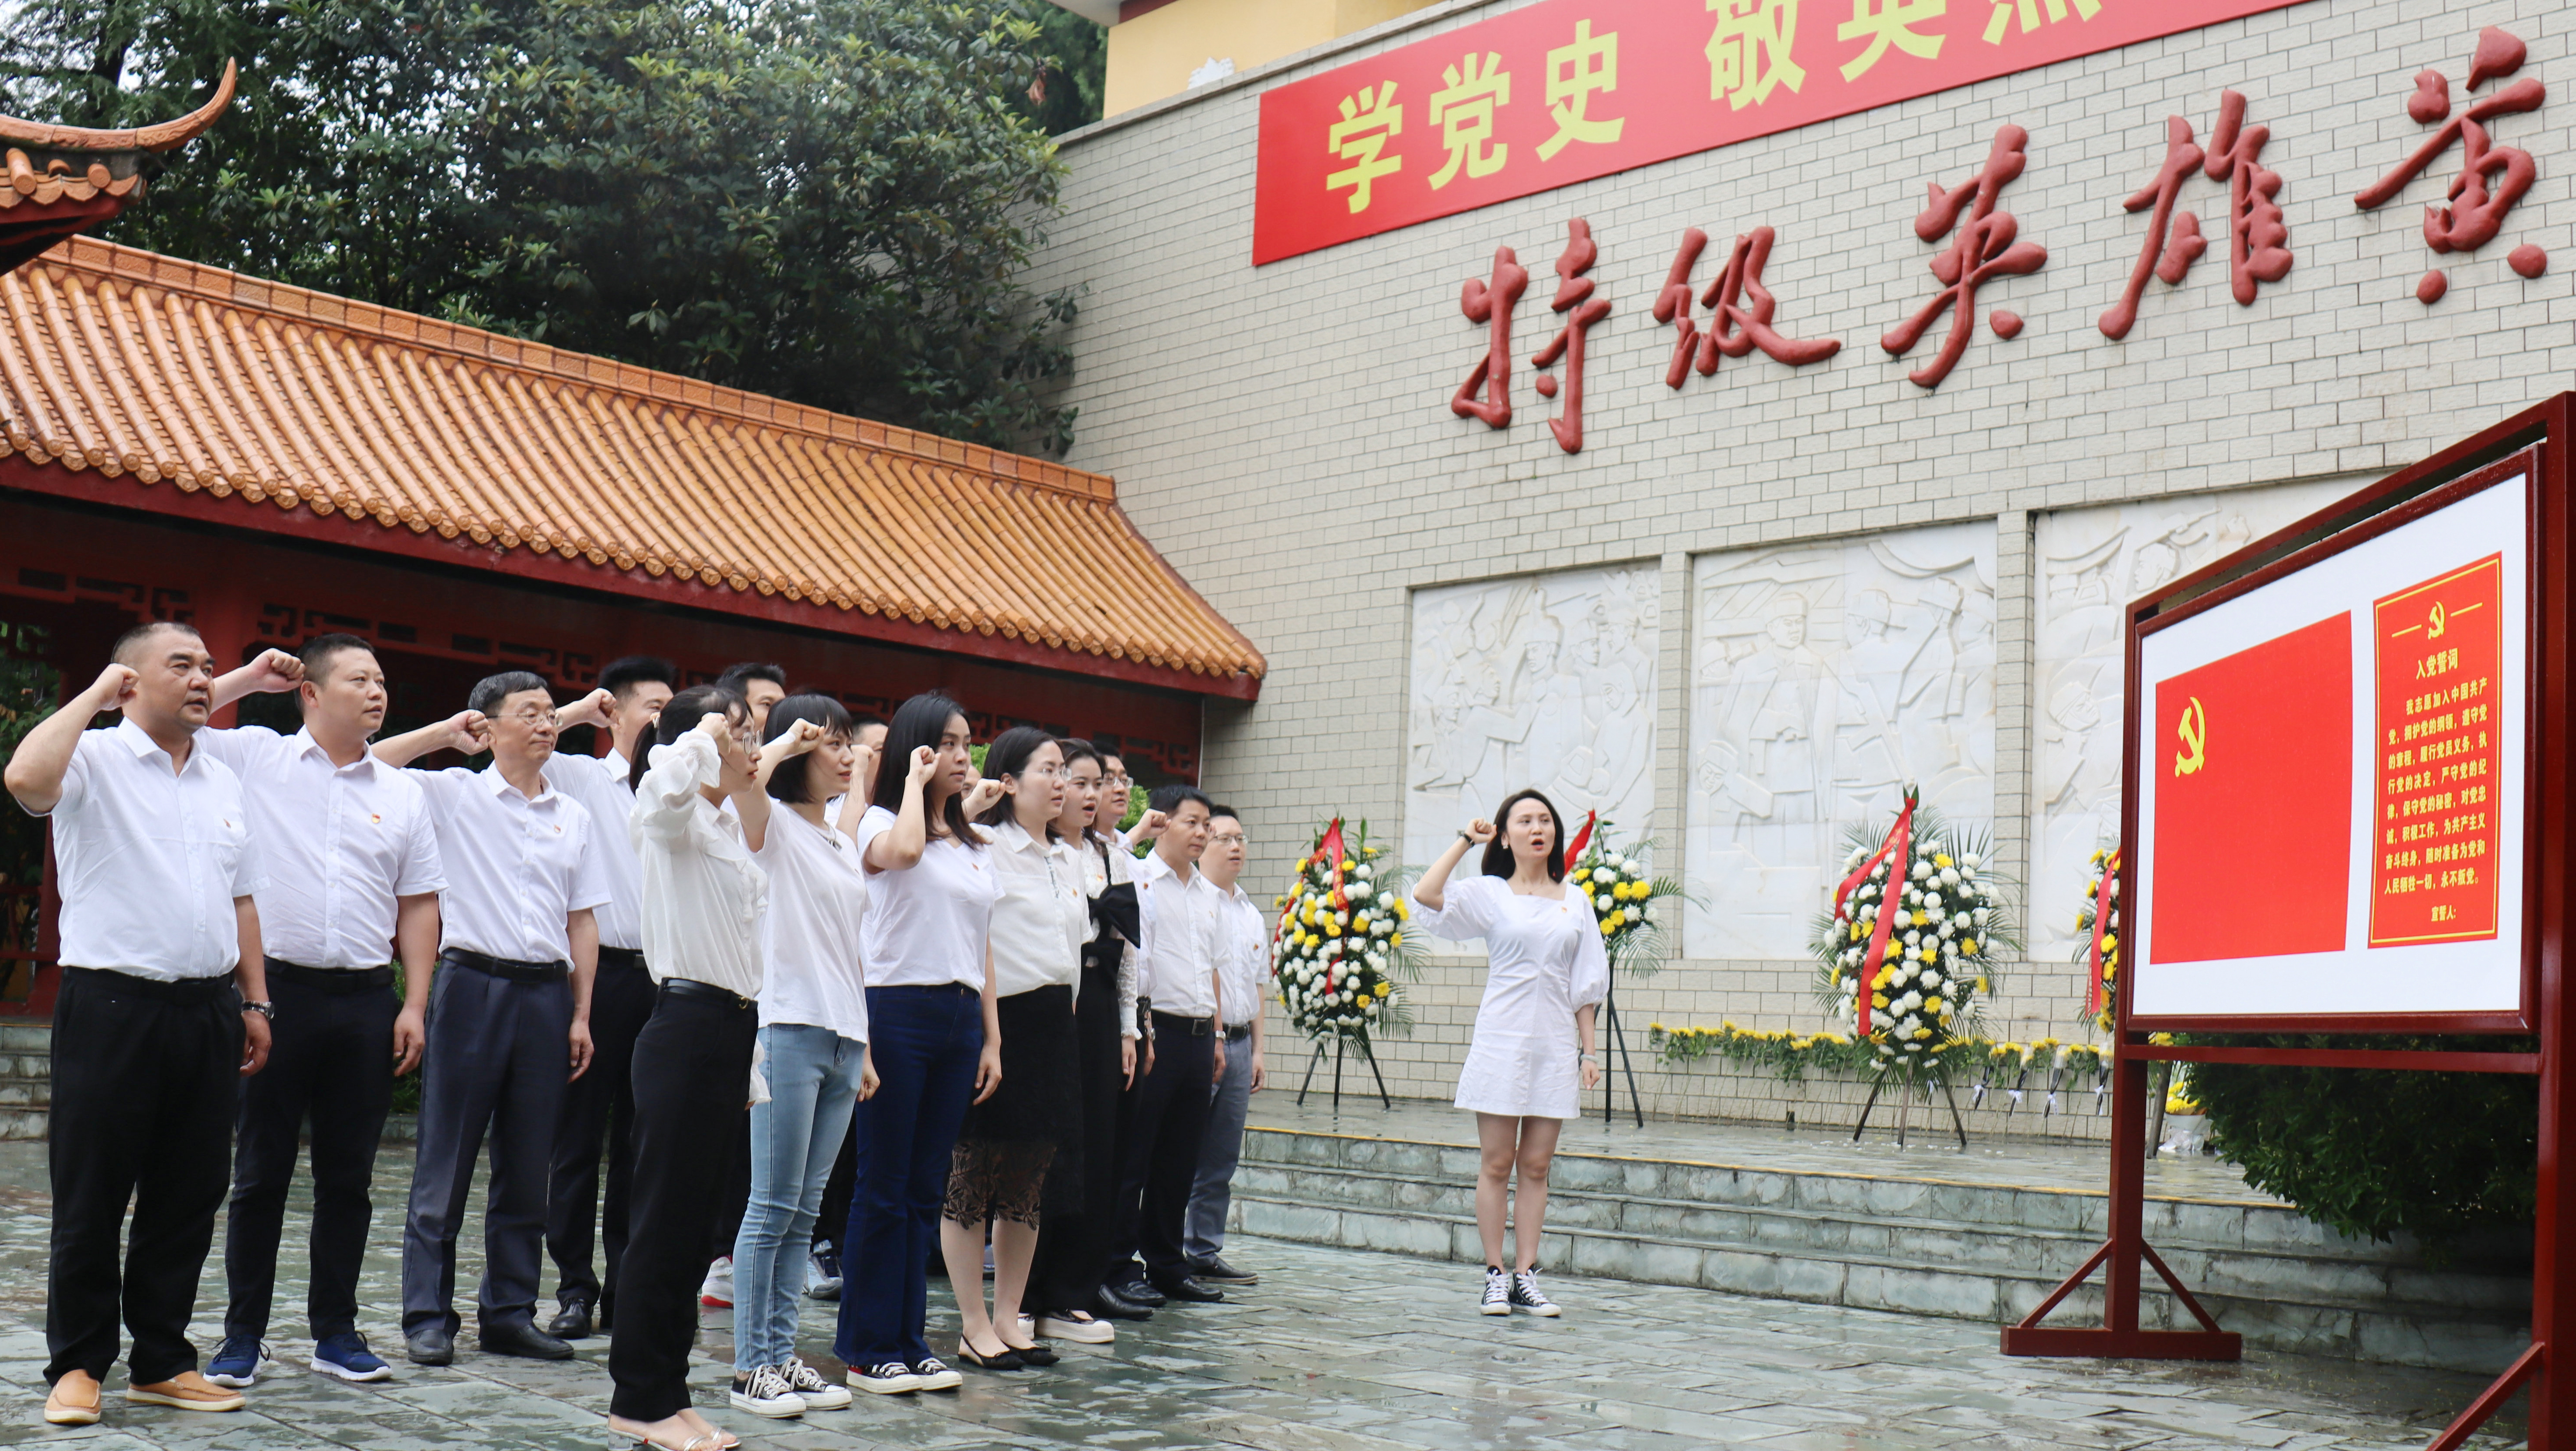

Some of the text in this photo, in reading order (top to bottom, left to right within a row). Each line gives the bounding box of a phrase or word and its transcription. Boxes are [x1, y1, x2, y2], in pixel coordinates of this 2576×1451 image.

[1326, 19, 1625, 214] 学党史
[2416, 648, 2458, 680] 入党誓词
[2406, 677, 2488, 715] 我志愿加入中国共产
[2388, 703, 2488, 746] 党，拥护党的纲领，遵守党
[2388, 730, 2488, 770] 的章程，履行党员义务，执
[2388, 758, 2487, 795] 行党的决定，严守党的纪
[2387, 784, 2486, 820] 律，保守党的秘密，对党忠
[2386, 812, 2486, 845] 诚，积极工作，为共产主义
[2386, 839, 2485, 870] 奋斗终身，随时准备为党和
[2384, 867, 2479, 895] 人民牺牲一切，永不叛党。
